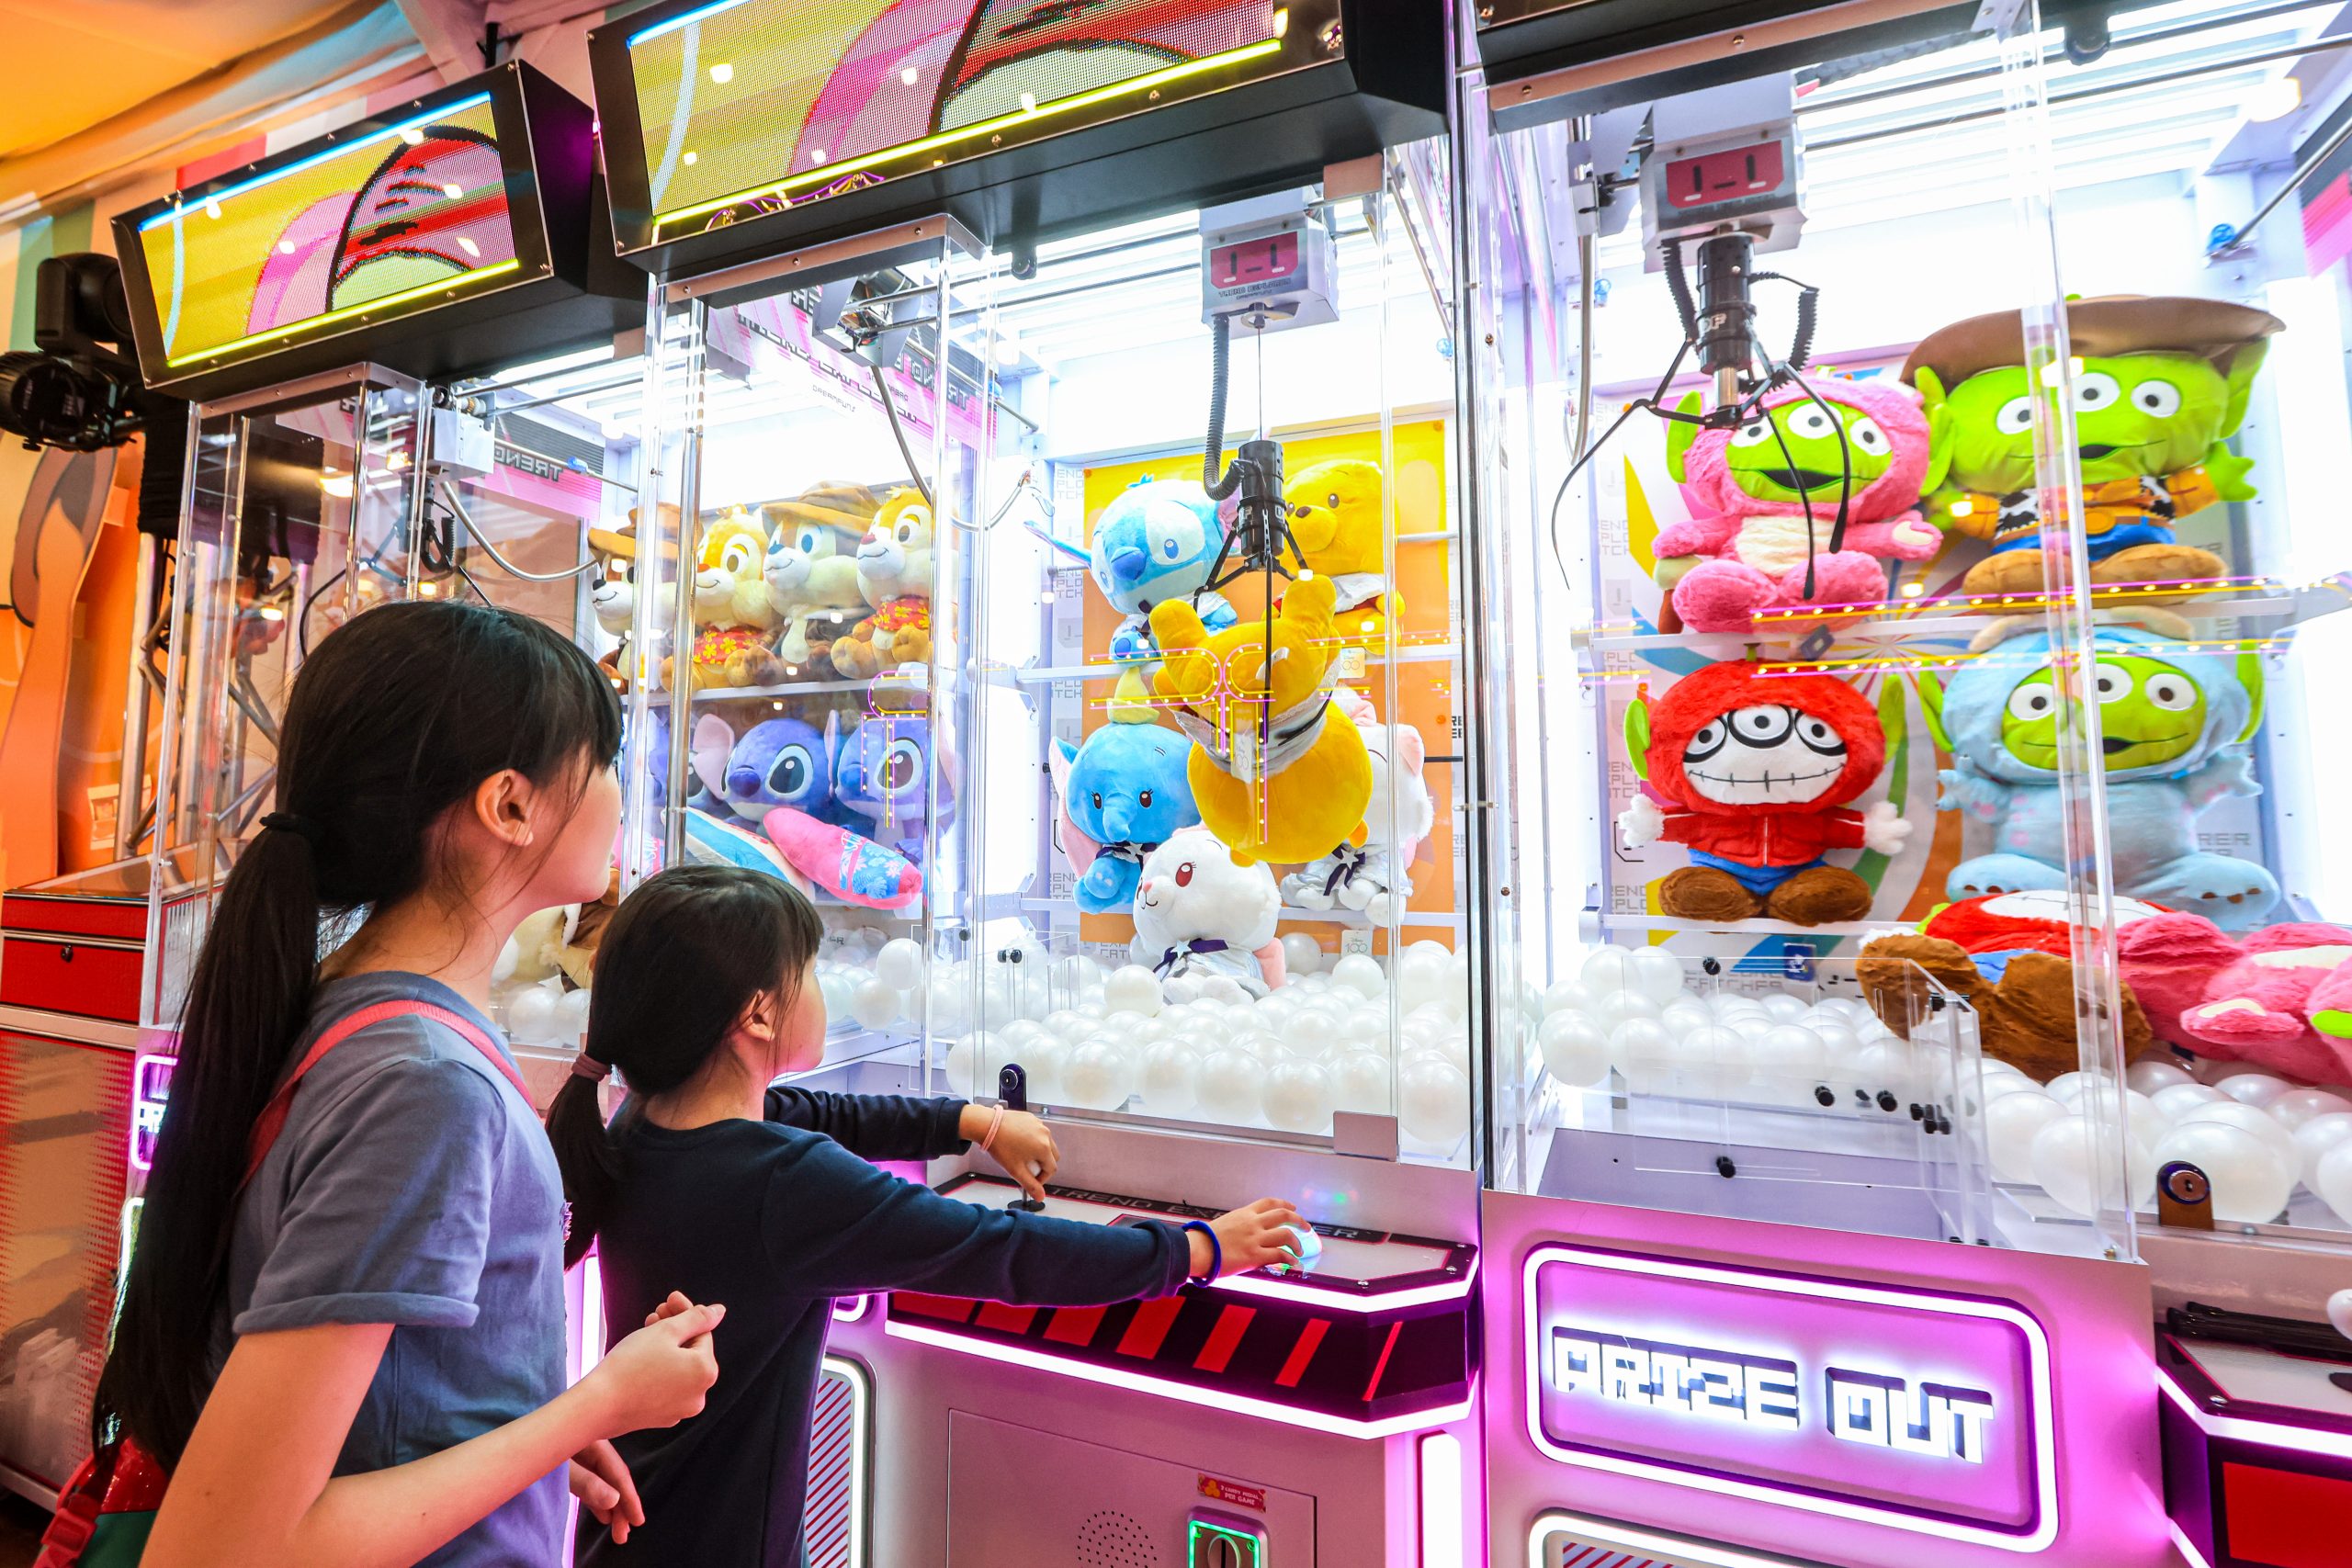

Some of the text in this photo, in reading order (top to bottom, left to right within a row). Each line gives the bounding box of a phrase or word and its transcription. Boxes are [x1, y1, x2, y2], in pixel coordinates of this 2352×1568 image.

[1052, 1187, 1152, 1209] TREND
[1552, 1325, 1995, 1465] PRIZE OUT
[1224, 1492, 1255, 1506] PER GAME
